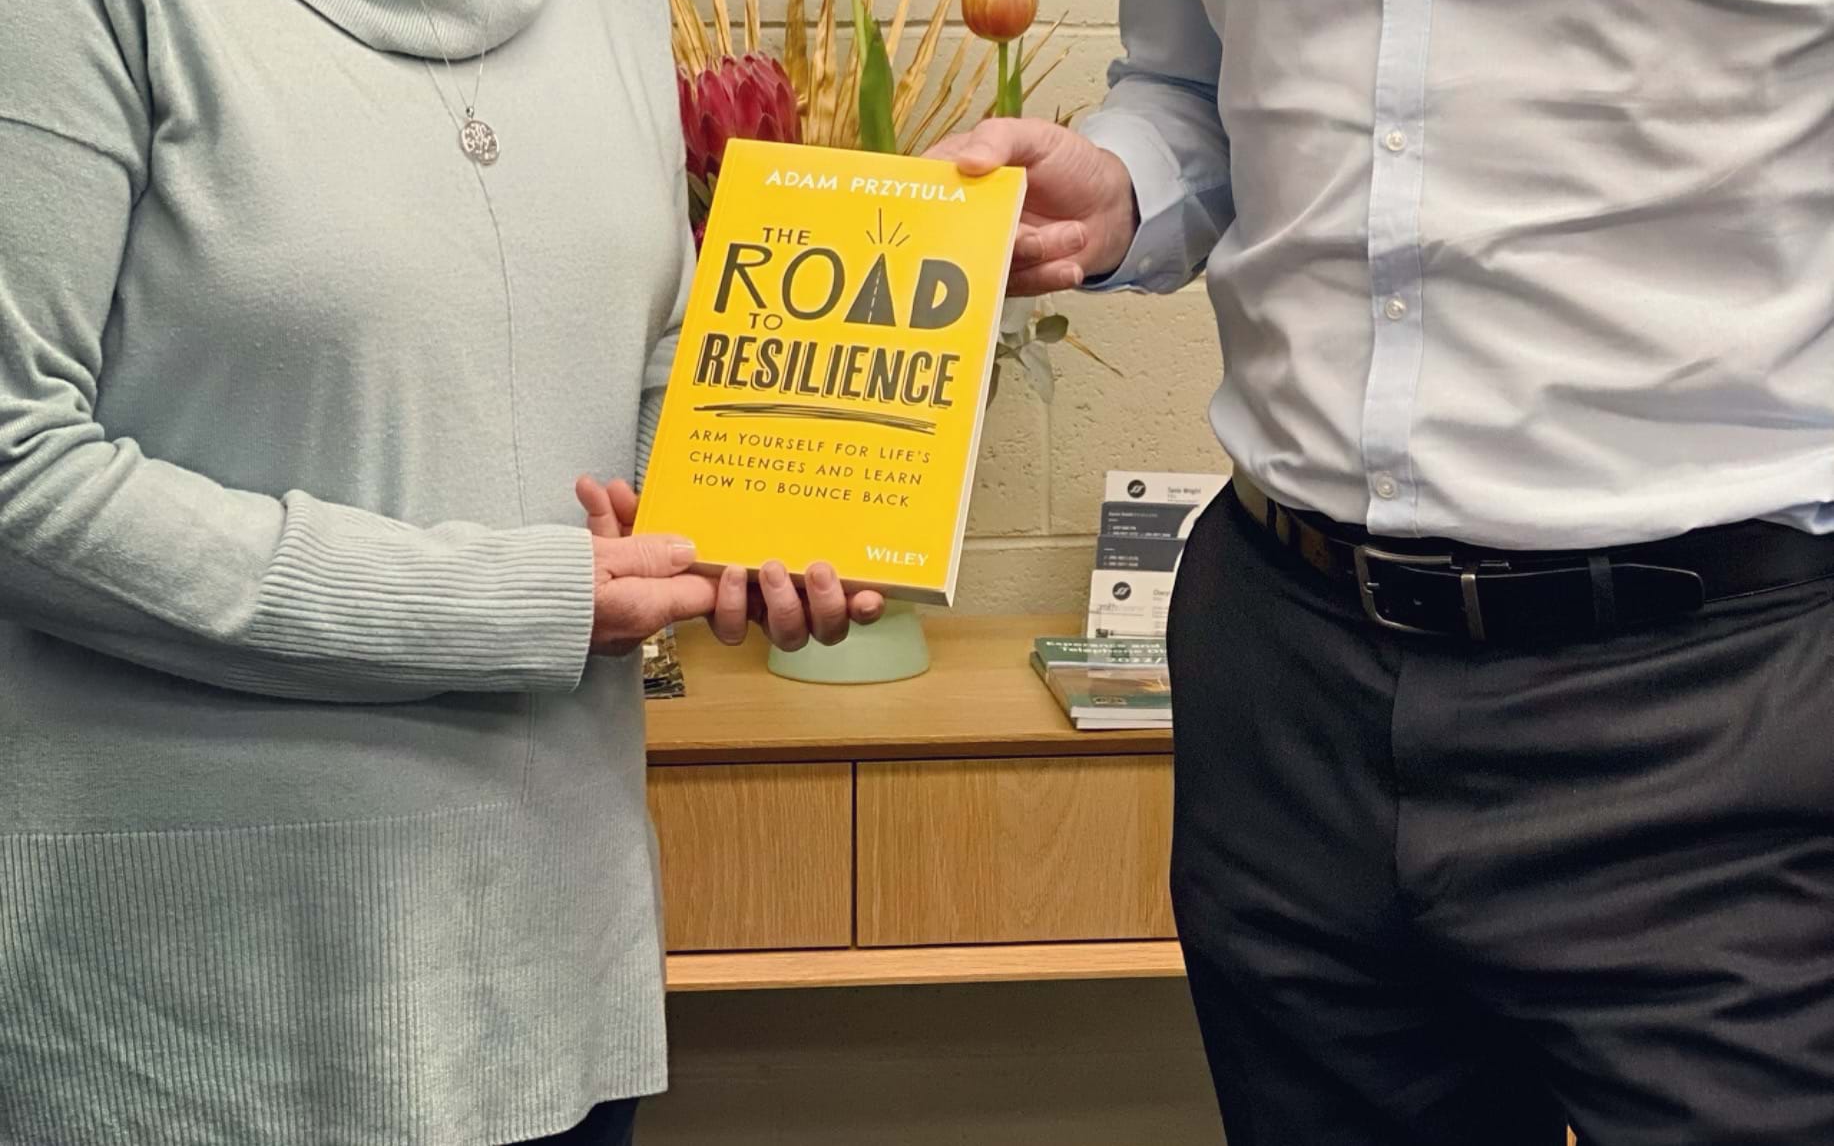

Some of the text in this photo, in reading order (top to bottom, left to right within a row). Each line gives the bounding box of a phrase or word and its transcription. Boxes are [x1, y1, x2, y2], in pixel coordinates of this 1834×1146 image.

[766, 169, 967, 202] ADAM PRZYTULA
[762, 227, 812, 245] THE
[714, 242, 970, 330] ROAD
[749, 312, 783, 331] TO
[693, 333, 961, 408] RESILIENCE
[689, 429, 931, 464] ARM YOURSELF FOR LIFE'S
[689, 450, 922, 485] CHALLENGES AND LEARN
[693, 473, 910, 508] HOW TO BOUNCE BACK
[865, 545, 929, 567] WILEY
